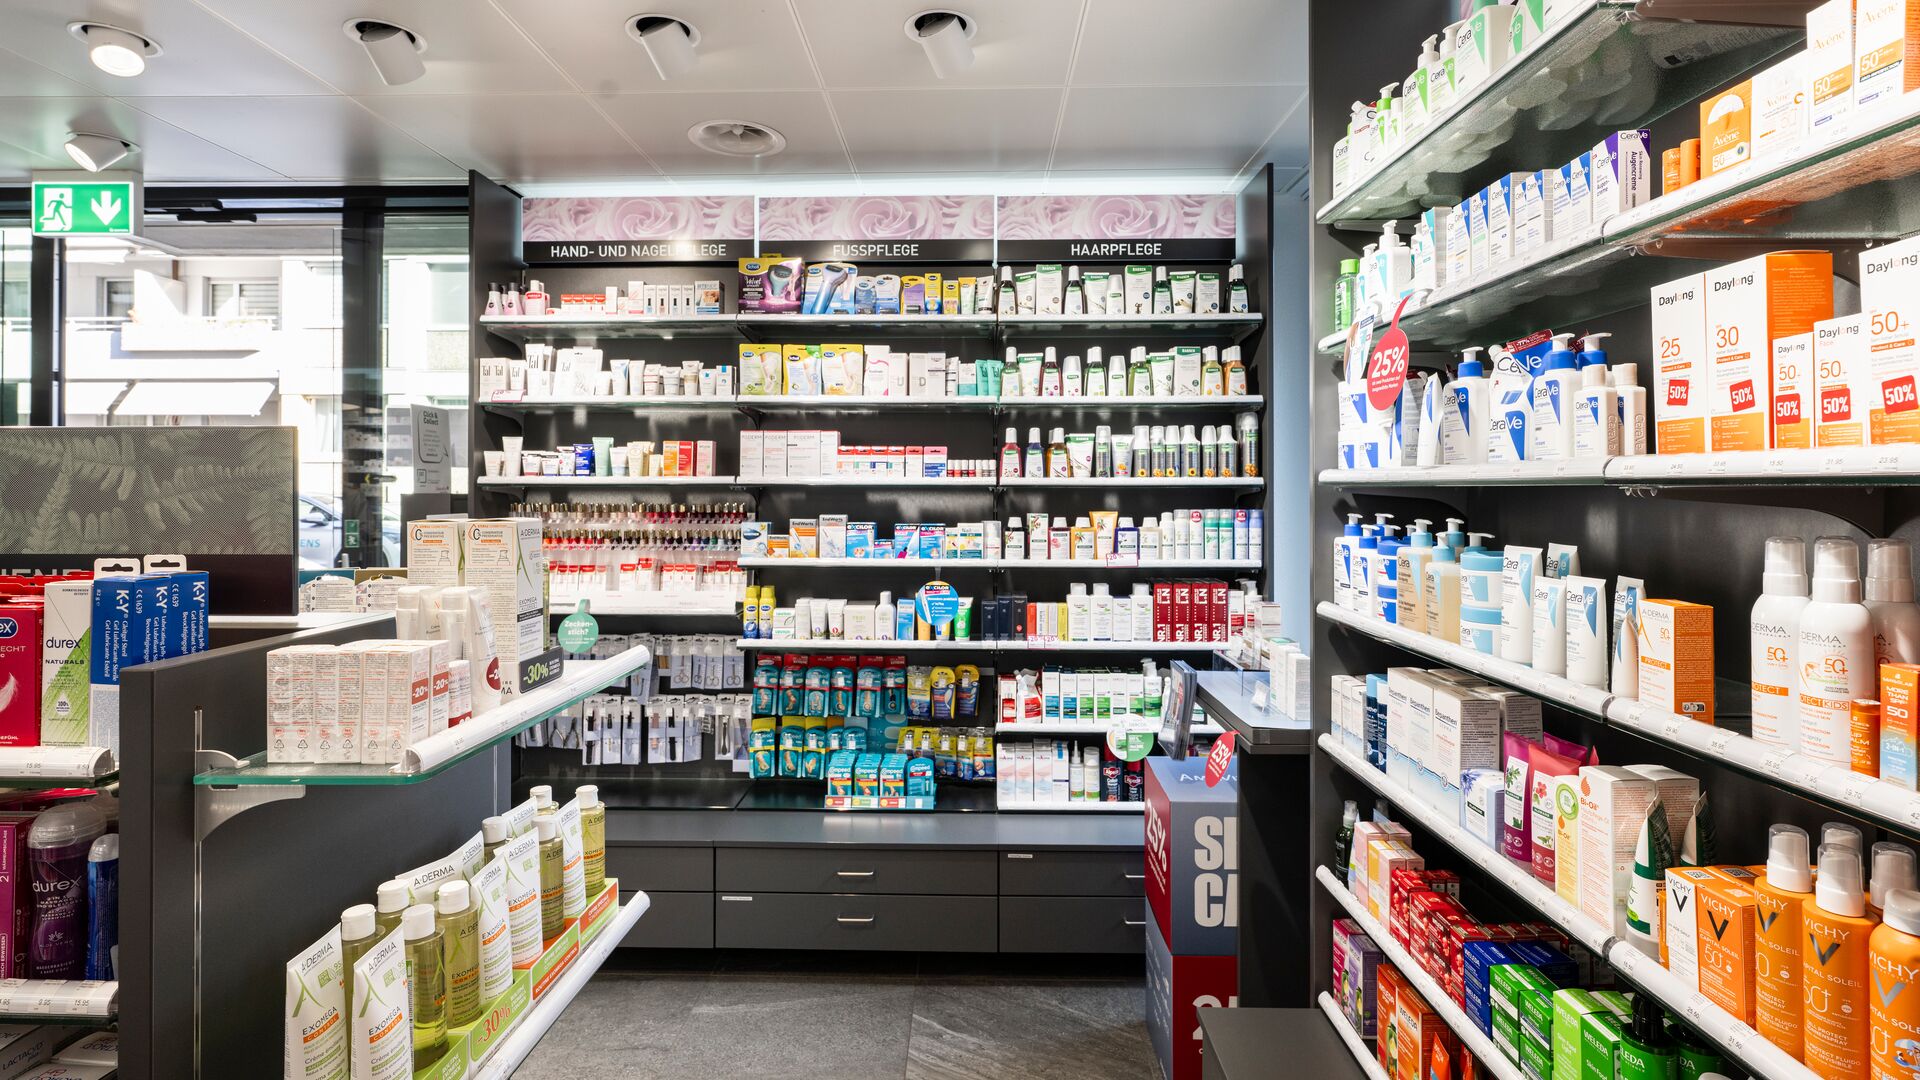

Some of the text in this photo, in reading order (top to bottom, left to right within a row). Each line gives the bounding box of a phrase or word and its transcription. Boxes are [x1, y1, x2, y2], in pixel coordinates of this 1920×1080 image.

[1620, 131, 1648, 140] CeraVe
[551, 244, 727, 258] HAND- UND NAGELLEGE
[832, 245, 919, 257] FUSSPFLEGE
[1071, 243, 1162, 256] HAARPFLEGE
[1867, 252, 1919, 275] Daylong
[1714, 272, 1755, 292] Daylong
[1658, 288, 1694, 307] Daylong
[1819, 324, 1860, 339] Daylong
[1870, 311, 1910, 336] 50+
[1716, 326, 1739, 349] 30
[1661, 337, 1681, 359] 25
[1371, 345, 1406, 378] 25%
[1669, 385, 1687, 399] 50%
[1732, 386, 1753, 405] 50%
[1885, 384, 1915, 405] 50%
[1575, 400, 1598, 410] CeraVe
[1777, 400, 1799, 417] 50%
[1823, 397, 1849, 415] 50%
[564, 620, 593, 628] Zecken-
[567, 628, 590, 636] stich?
[46, 637, 82, 648] durex
[1645, 657, 1668, 670] PROTECT
[523, 663, 549, 684] -30%
[1886, 686, 1909, 695] MORE
[1887, 692, 1909, 701] THAN
[1824, 701, 1849, 711] KIDS
[1886, 706, 1909, 719] 50
[1211, 740, 1232, 770] 25%
[1580, 797, 1599, 811] Bi-Oil
[1147, 799, 1167, 873] 25%
[33, 875, 82, 893] durex
[1668, 877, 1691, 895] VICHY
[1701, 894, 1736, 919] VICHY
[1804, 917, 1850, 941] VICHY
[1699, 933, 1740, 960] CAPITAL SOLEIL
[1768, 941, 1801, 957] SOLEIL
[1827, 974, 1863, 988] SOLEIL
[1399, 1004, 1418, 1032] WELEDA
[1555, 1004, 1579, 1029] WELEDA
[1686, 1006, 1700, 1020] 25.50
[476, 1005, 511, 1045] -30%
[1583, 1029, 1609, 1057] WELEDA
[1728, 1035, 1743, 1050] 31.50
